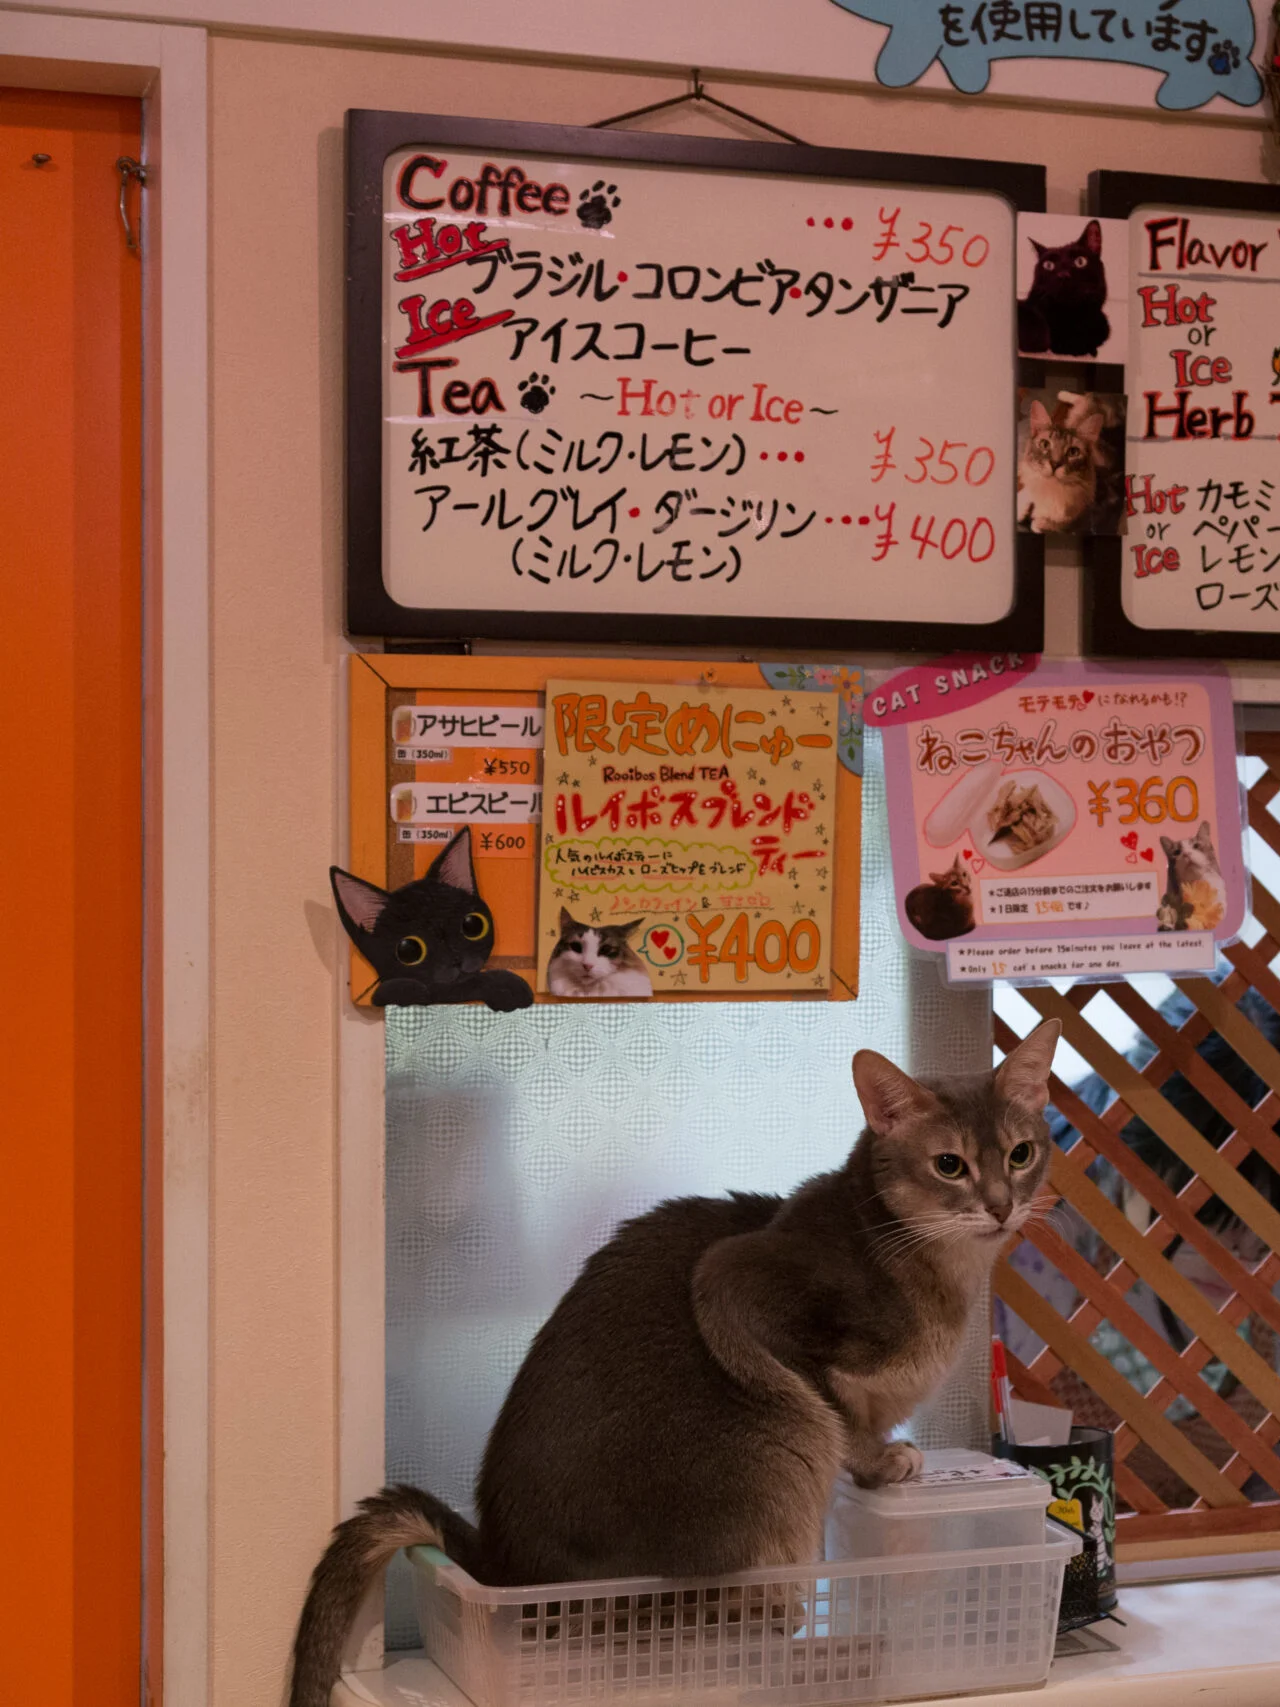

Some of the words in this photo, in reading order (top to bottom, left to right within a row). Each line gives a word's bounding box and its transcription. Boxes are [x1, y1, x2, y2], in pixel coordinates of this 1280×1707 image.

[940, 2, 1219, 62] を使用しています
[397, 154, 571, 216] Coffee
[391, 217, 487, 269] Hot
[873, 207, 990, 267] ¥350
[1145, 217, 1268, 271] Flavor
[398, 294, 481, 345] Ice
[1137, 284, 1217, 327] Hot
[502, 317, 751, 367] アイスコーヒー
[1188, 325, 1217, 346] or
[393, 357, 506, 417] Tea
[1169, 350, 1232, 388] Ice
[709, 393, 744, 420] or
[1143, 390, 1255, 441] Herb
[871, 426, 994, 486] ¥350
[415, 486, 816, 541] アールグレイ・ダージリン
[1125, 474, 1188, 517] Hot
[872, 502, 994, 562] ¥400
[1147, 523, 1171, 541] or
[512, 535, 740, 583] (ミルク・レモン)
[1131, 544, 1180, 578] Ice
[871, 684, 921, 717] CAT
[935, 651, 1025, 696] SNACK
[1018, 693, 1080, 713] モテモテ
[417, 714, 542, 737] アサヒビール
[552, 691, 832, 765] 限定めにゅー
[917, 716, 1206, 775] ねこちゃんのおやつ
[483, 758, 530, 776] ¥550
[603, 765, 655, 783] Rooibos
[659, 765, 696, 782] Blend
[700, 765, 729, 780] TEA
[1087, 775, 1199, 827] ¥360
[480, 832, 525, 851] ¥600
[751, 836, 827, 876] ティー
[686, 912, 821, 983] ¥400
[967, 947, 994, 956] Please
[998, 945, 1021, 955] order
[1025, 944, 1052, 954] before
[1102, 943, 1116, 952] you
[1120, 941, 1141, 951] leave
[1146, 940, 1154, 949] at
[1159, 939, 1172, 948] the
[968, 964, 987, 975] Only
[1041, 961, 1067, 970] snacks
[1071, 961, 1085, 970] for
[1089, 961, 1103, 969] one
